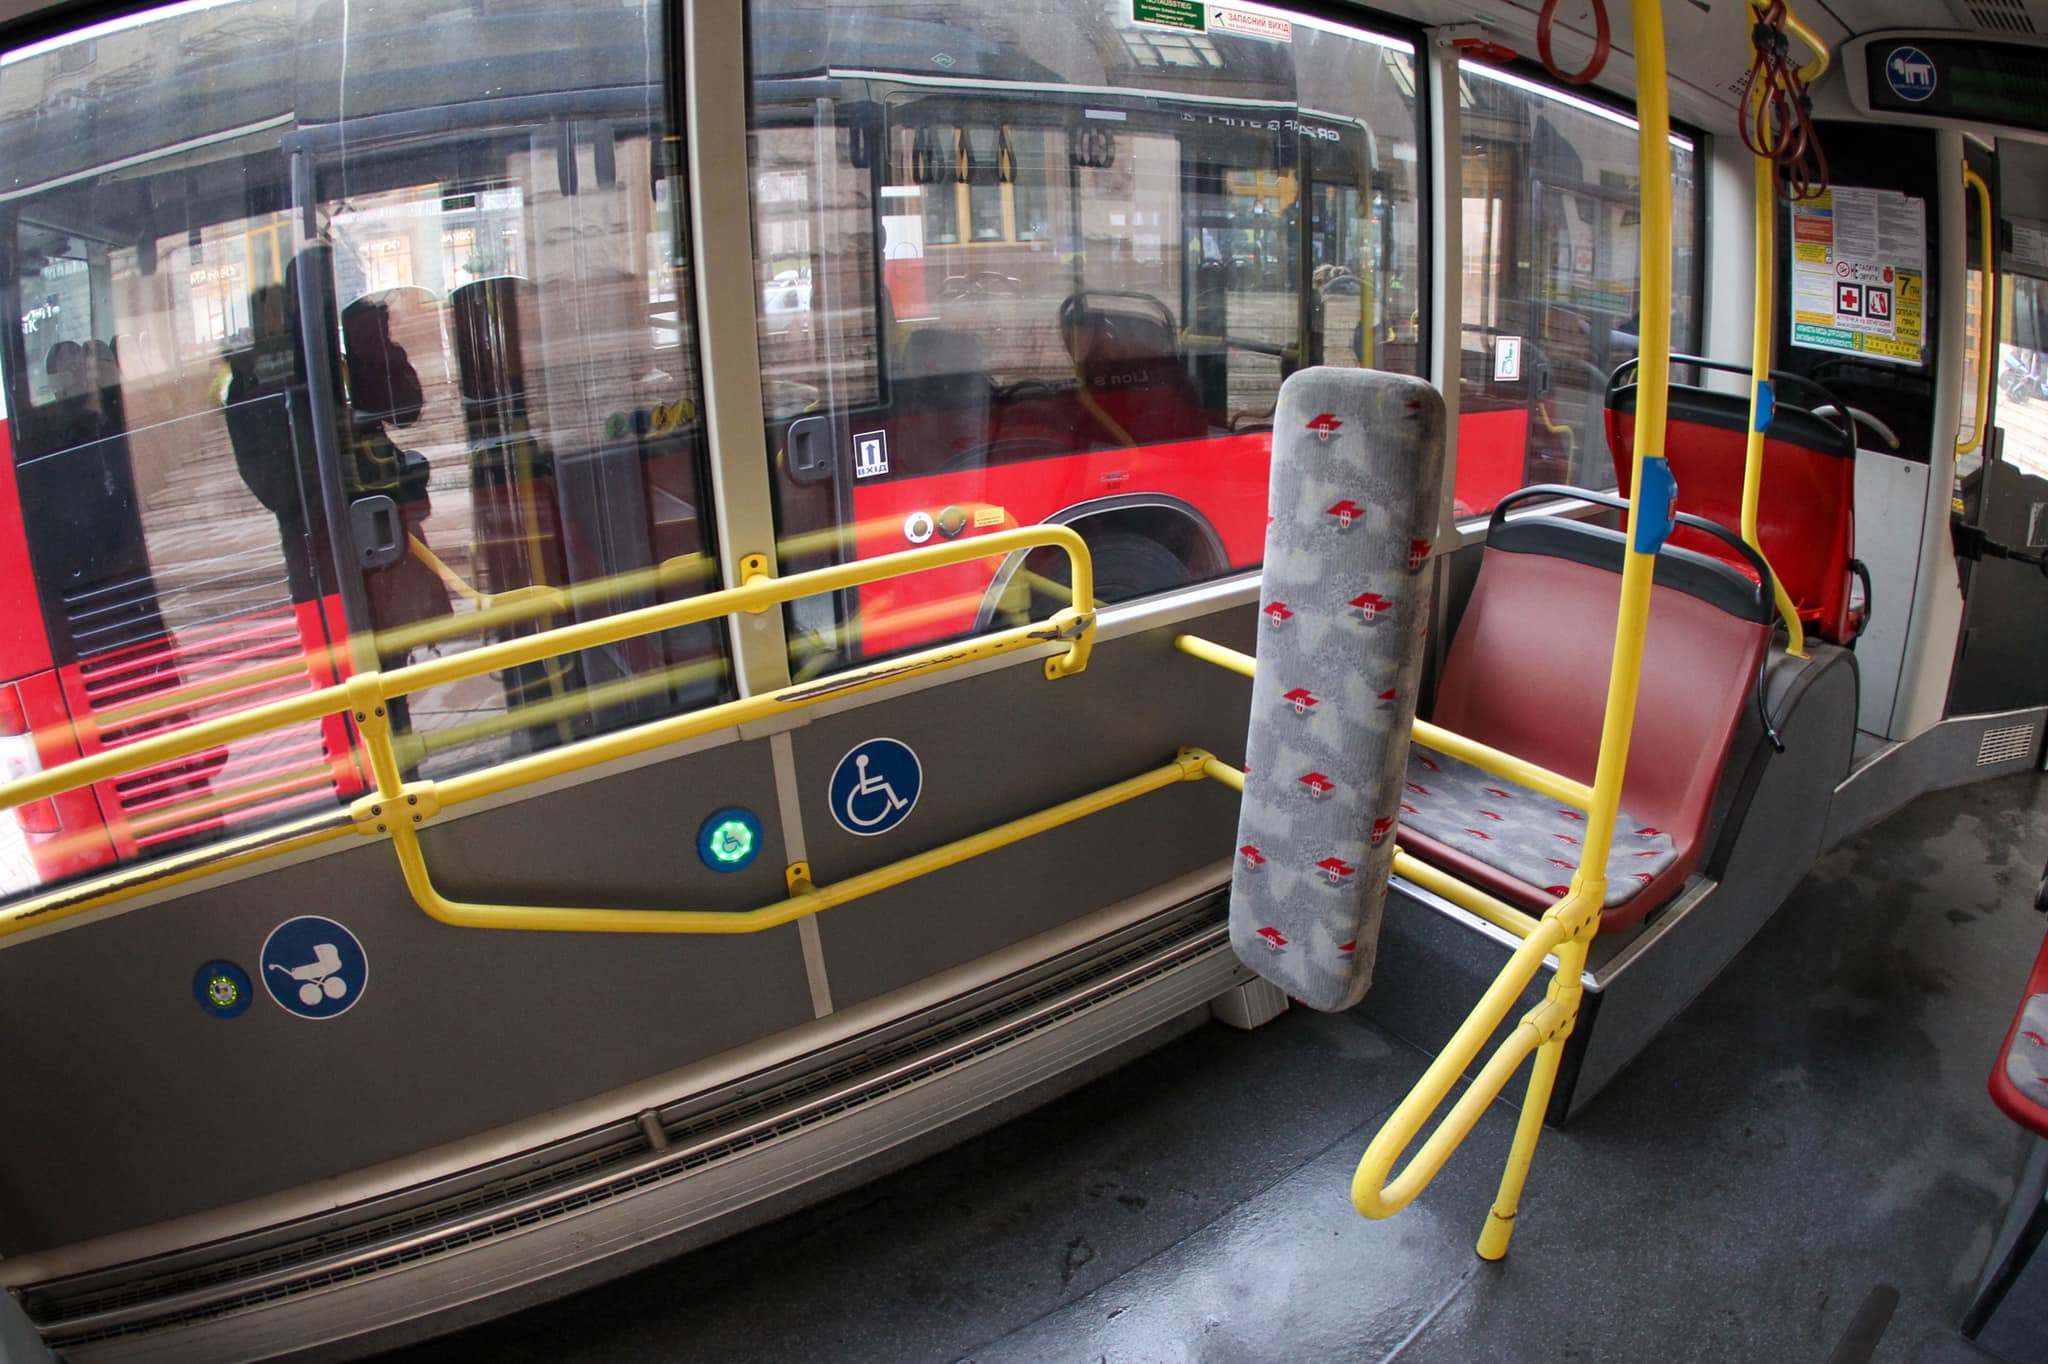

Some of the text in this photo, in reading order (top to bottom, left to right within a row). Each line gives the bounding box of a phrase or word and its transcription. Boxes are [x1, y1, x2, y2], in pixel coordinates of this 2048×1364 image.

[1268, 20, 1289, 32] ВИХІД
[1898, 276, 1911, 296] 7
[858, 464, 887, 476] ВХІД
